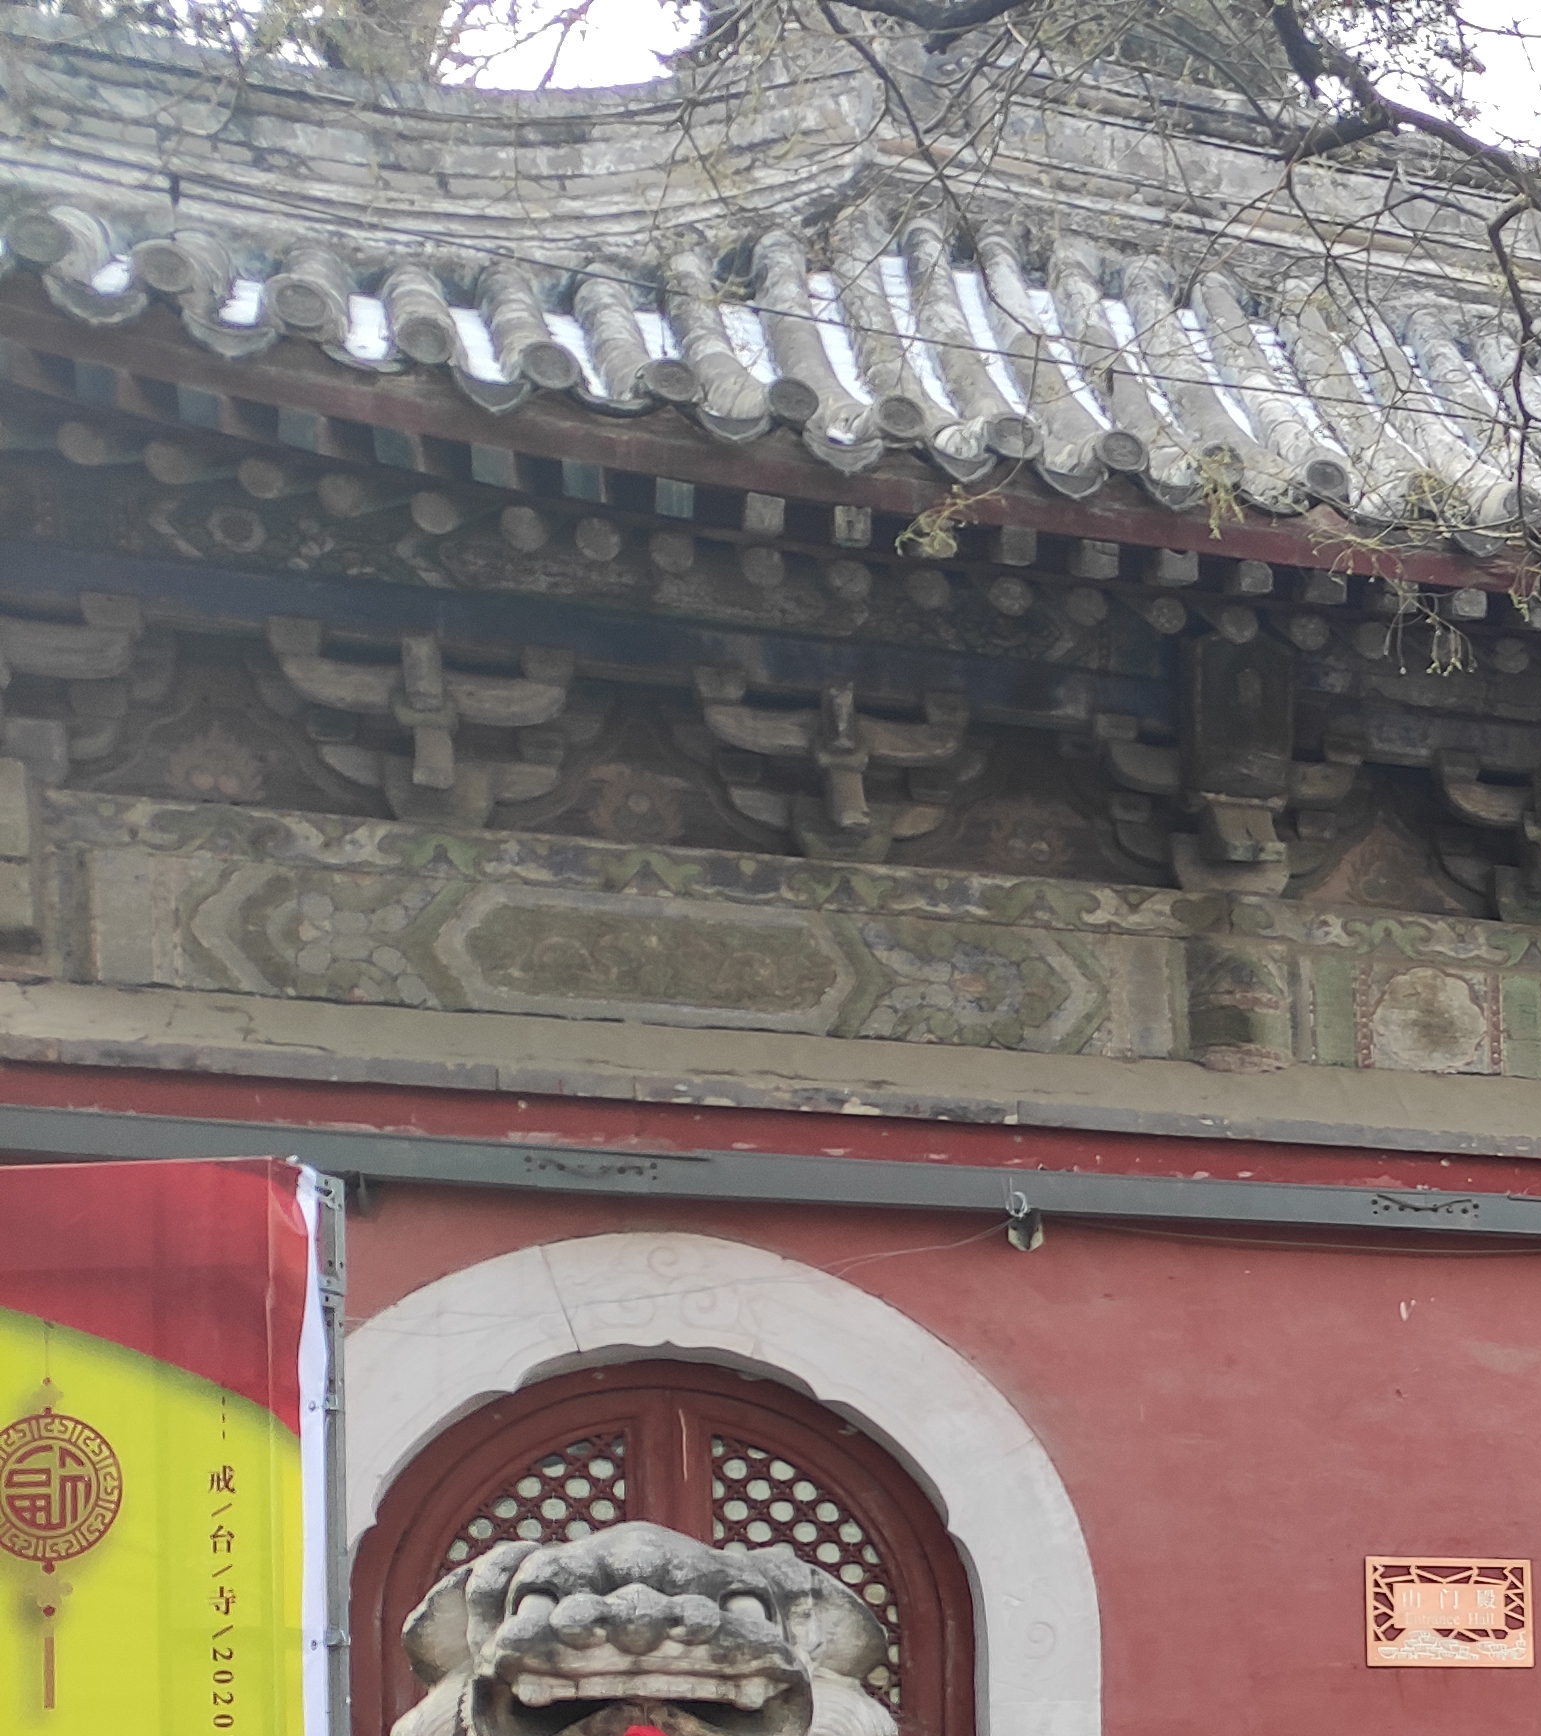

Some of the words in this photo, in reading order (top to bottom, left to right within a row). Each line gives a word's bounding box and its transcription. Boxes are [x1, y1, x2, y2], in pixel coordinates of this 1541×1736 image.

[1402, 1589, 1497, 1609] 山门殿
[1405, 1612, 1460, 1626] Entrance
[1468, 1612, 1495, 1626] Hall
